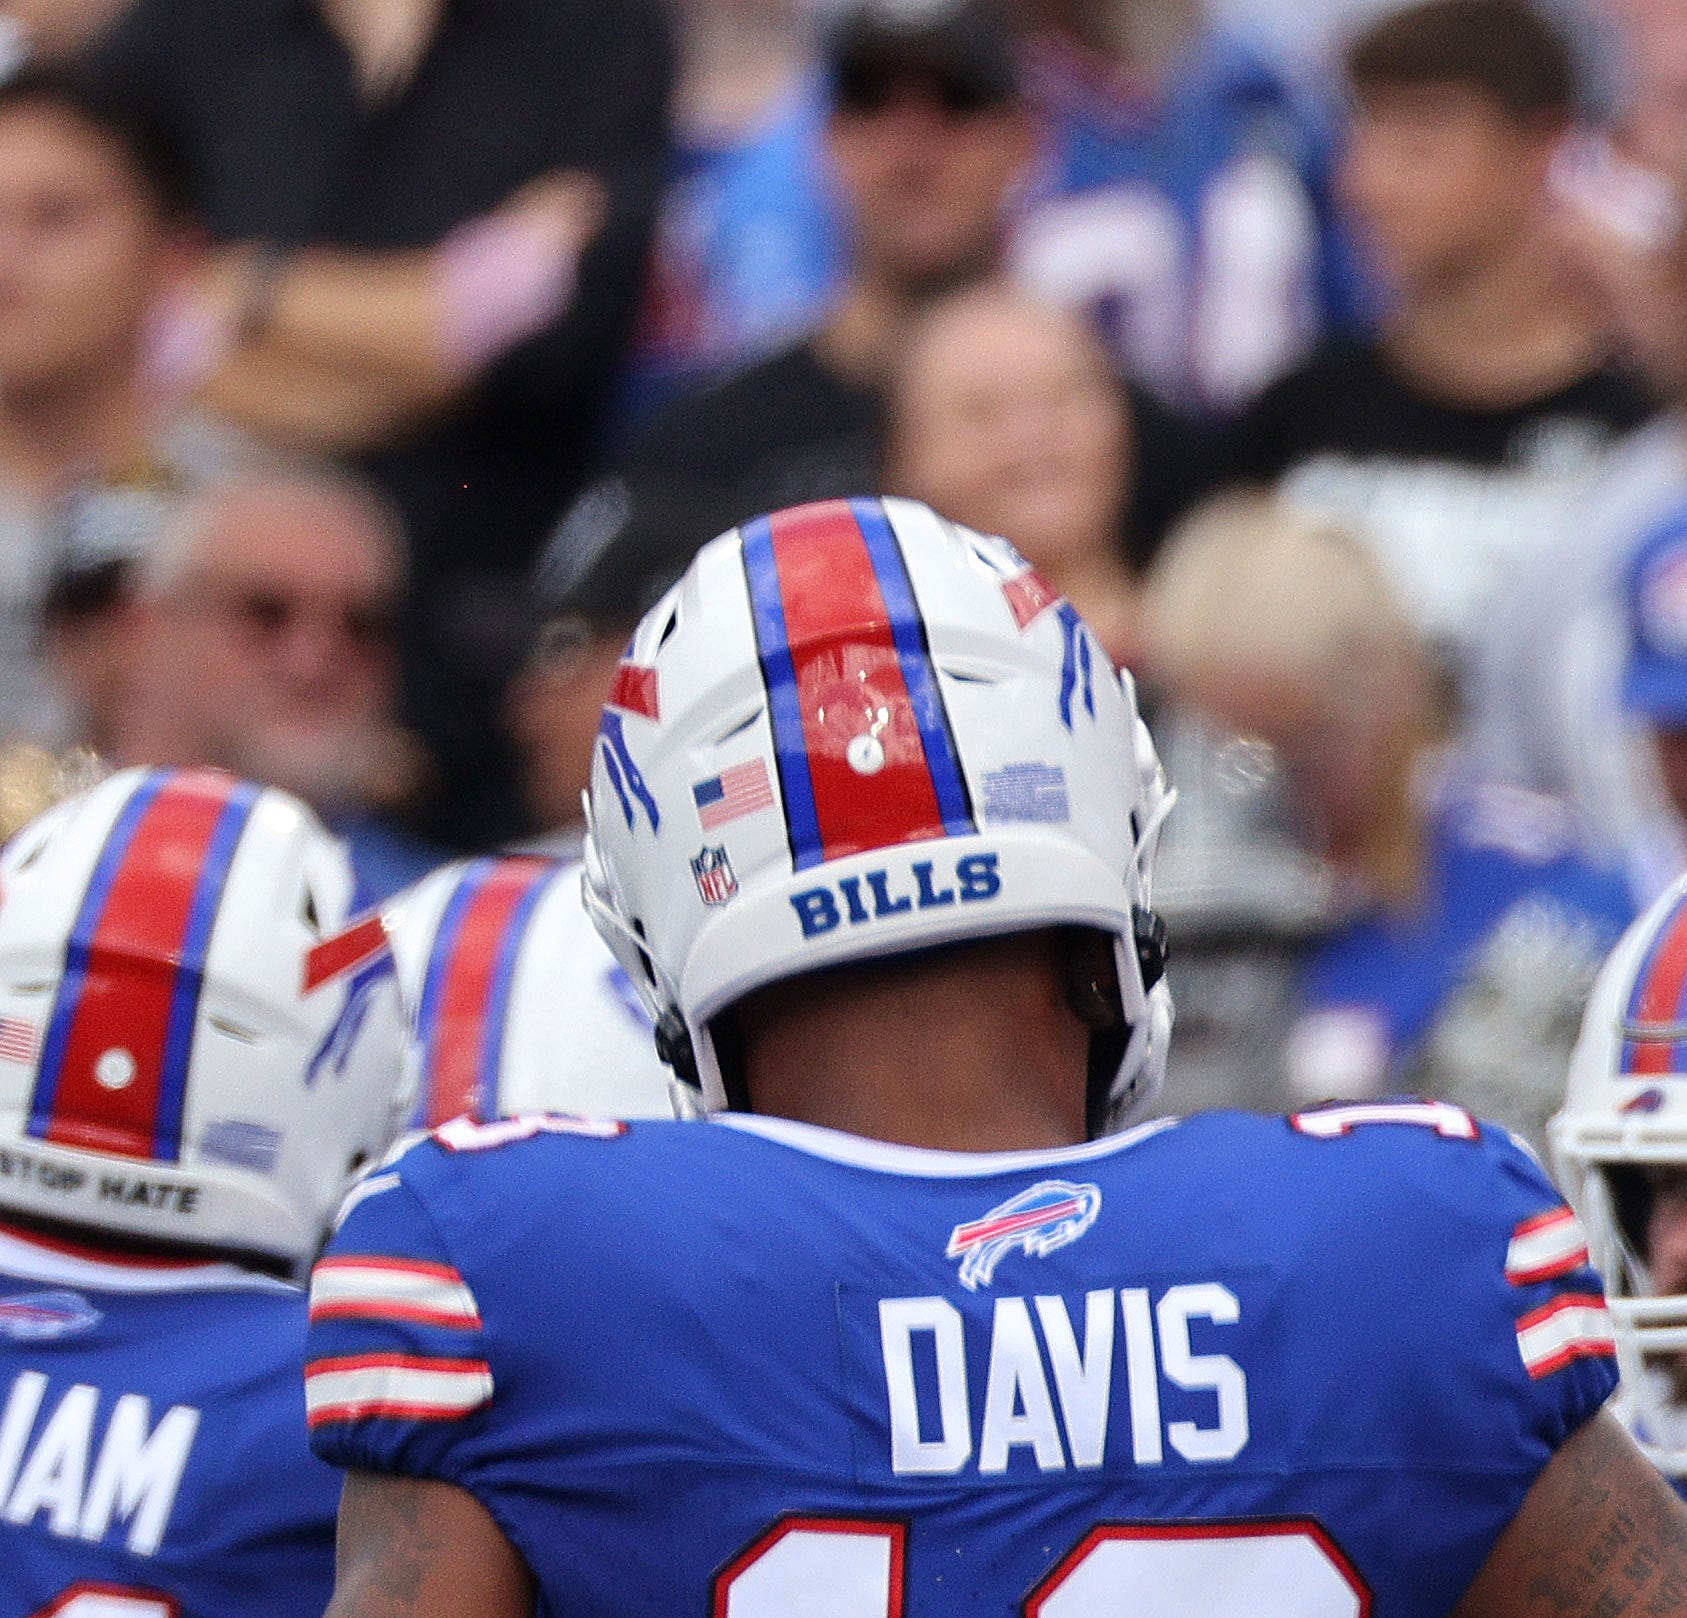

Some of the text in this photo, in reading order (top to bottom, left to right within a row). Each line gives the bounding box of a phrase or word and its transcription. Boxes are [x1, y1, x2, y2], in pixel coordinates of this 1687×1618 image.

[790, 851, 1004, 940] BILLS
[100, 1174, 200, 1214] HATE
[877, 1280, 1253, 1478] DAVIS
